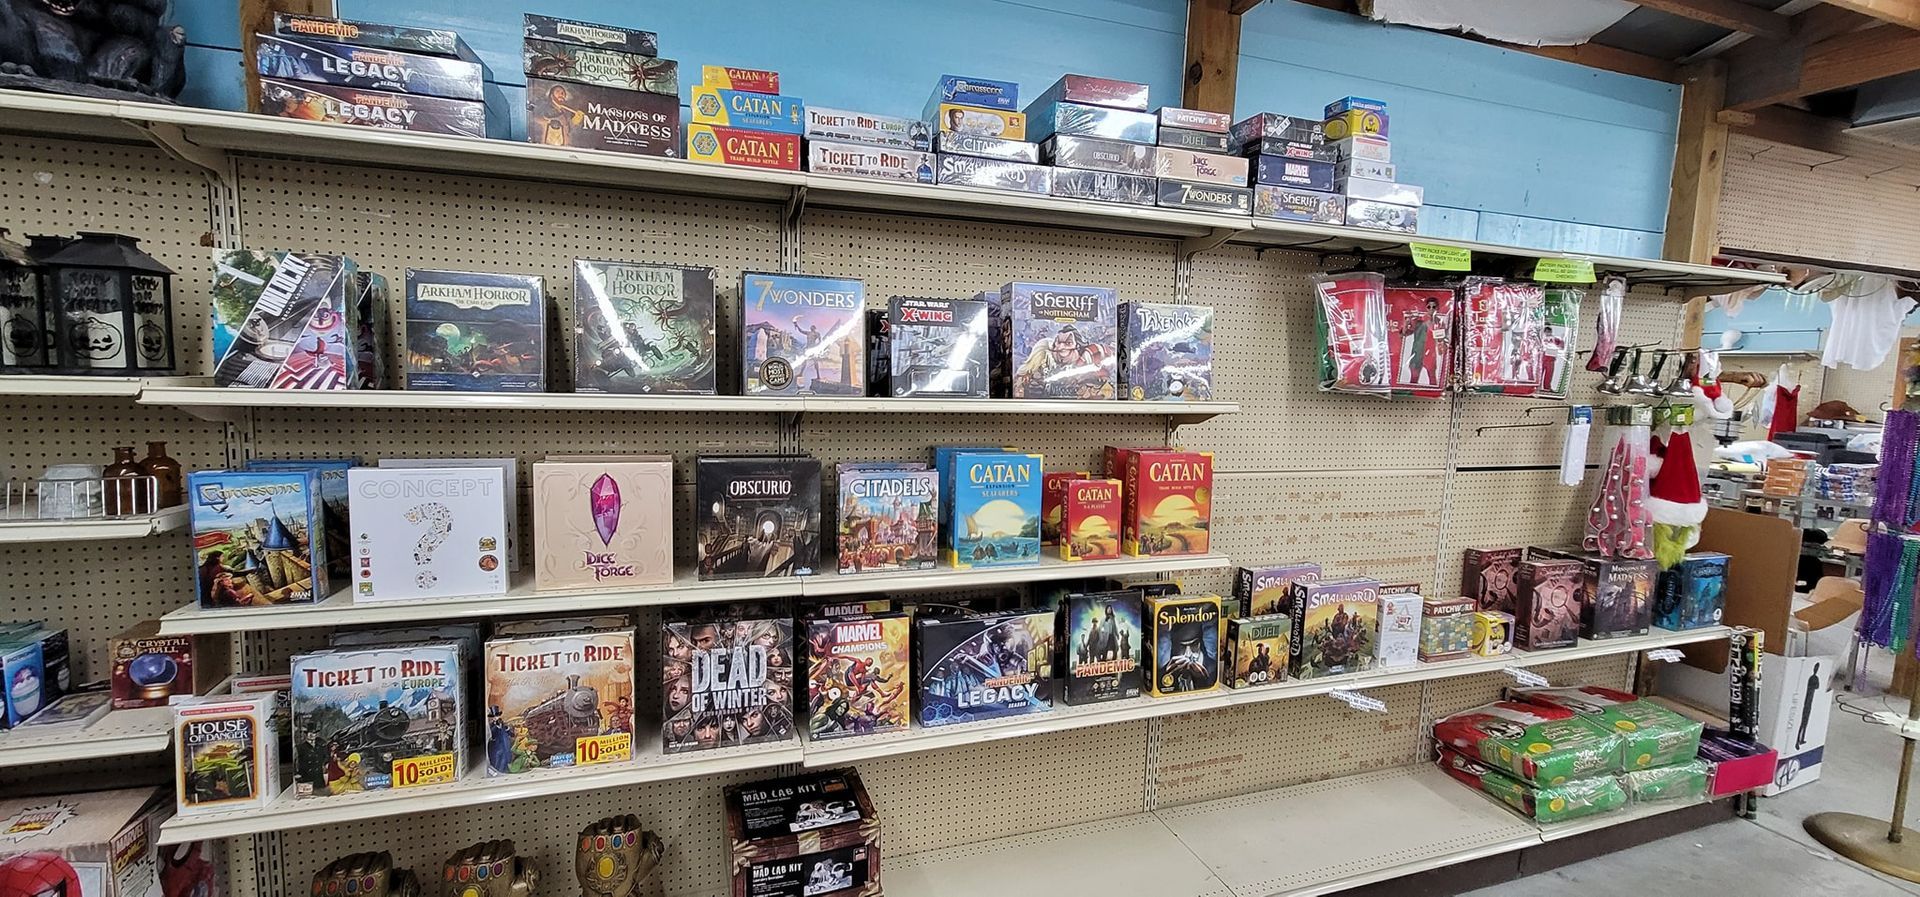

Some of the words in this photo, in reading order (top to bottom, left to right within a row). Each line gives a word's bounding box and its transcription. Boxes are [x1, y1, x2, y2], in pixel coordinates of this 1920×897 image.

[291, 19, 358, 38] PANDEMIC
[559, 24, 592, 37] ARKHAM
[591, 29, 625, 43] HORROR
[351, 51, 405, 66] PANDEMIC
[581, 53, 624, 68] ARKHAM
[322, 57, 412, 82] LEGACY
[579, 63, 627, 80] HORROR
[729, 69, 758, 81] CATAN
[355, 94, 408, 109] PANDEMIC
[732, 95, 782, 115] CATAN
[325, 101, 417, 124] LEGACY
[588, 102, 649, 120] MANSIONS
[652, 113, 667, 123] OF
[809, 111, 845, 127] TICKET
[847, 118, 855, 127] TO
[857, 116, 879, 130] RIDE
[881, 121, 906, 133] EUROPE
[583, 114, 671, 139] MADNESS
[727, 137, 780, 159] CATAN
[1182, 135, 1207, 146] DUEL
[819, 147, 865, 166] TICKET
[867, 155, 878, 165] TO
[880, 153, 909, 169] RIDE
[1094, 174, 1118, 190] DEAD
[1181, 184, 1192, 204] 7
[1189, 190, 1233, 205] WONDERS
[615, 266, 675, 283] ARKHAM
[258, 254, 311, 317] UNLOCK!
[420, 285, 472, 299] ARKHAM
[474, 287, 528, 303] HORROR
[612, 280, 679, 299] HORROR
[754, 280, 773, 312] 7
[770, 289, 855, 308] WONDERS
[902, 300, 925, 308] STAR
[927, 301, 950, 309] WARS
[1034, 292, 1096, 311] SHERIFF
[901, 307, 952, 322] X-WING
[1043, 309, 1090, 319] NOTTINGHAM
[970, 463, 1030, 484] CATAN
[1149, 462, 1205, 482] CATAN
[202, 482, 301, 501] Carcassonne
[359, 479, 493, 499] CONCEPT
[730, 480, 791, 496] OBSCURIO
[850, 478, 930, 498] CITADELS
[1078, 488, 1112, 501] CATAN
[584, 551, 616, 565] DICE
[588, 565, 634, 583] FORGE
[1309, 588, 1376, 610] SMALLWORLD
[1159, 607, 1217, 631] Splendor
[837, 623, 882, 643] MARVEL
[1253, 625, 1277, 639] DUEL
[137, 639, 189, 648] CRYSTAL
[149, 645, 178, 653] BALL
[831, 642, 888, 654] CHAMPIONS
[496, 651, 561, 672] TICKET
[565, 651, 580, 664] TO
[583, 645, 623, 663] RIDE
[303, 666, 375, 689] TICKET
[379, 666, 397, 680] TO
[401, 659, 446, 678] RIDE
[691, 645, 768, 694] DEAD
[1075, 658, 1136, 679] PANDEMIC
[401, 677, 445, 690] EUROPE
[985, 673, 1031, 687] PANDEMIC
[692, 692, 708, 712] OF
[712, 687, 767, 710] WINTER
[958, 683, 1039, 708] LEGACY
[190, 719, 248, 735] HOUSE
[189, 734, 201, 743] OF
[206, 731, 248, 742] DANGER
[578, 740, 599, 763] 10
[600, 734, 629, 745] MILLION
[600, 742, 629, 755] SOLD!
[394, 762, 419, 786] 10
[419, 756, 452, 767] MILLION
[419, 764, 452, 777] SOLD!
[742, 791, 767, 803] MAD
[771, 788, 794, 798] LAB
[798, 783, 817, 793] KIT
[753, 868, 769, 879] MAD
[771, 866, 787, 875] LAB
[789, 862, 803, 872] KIT
